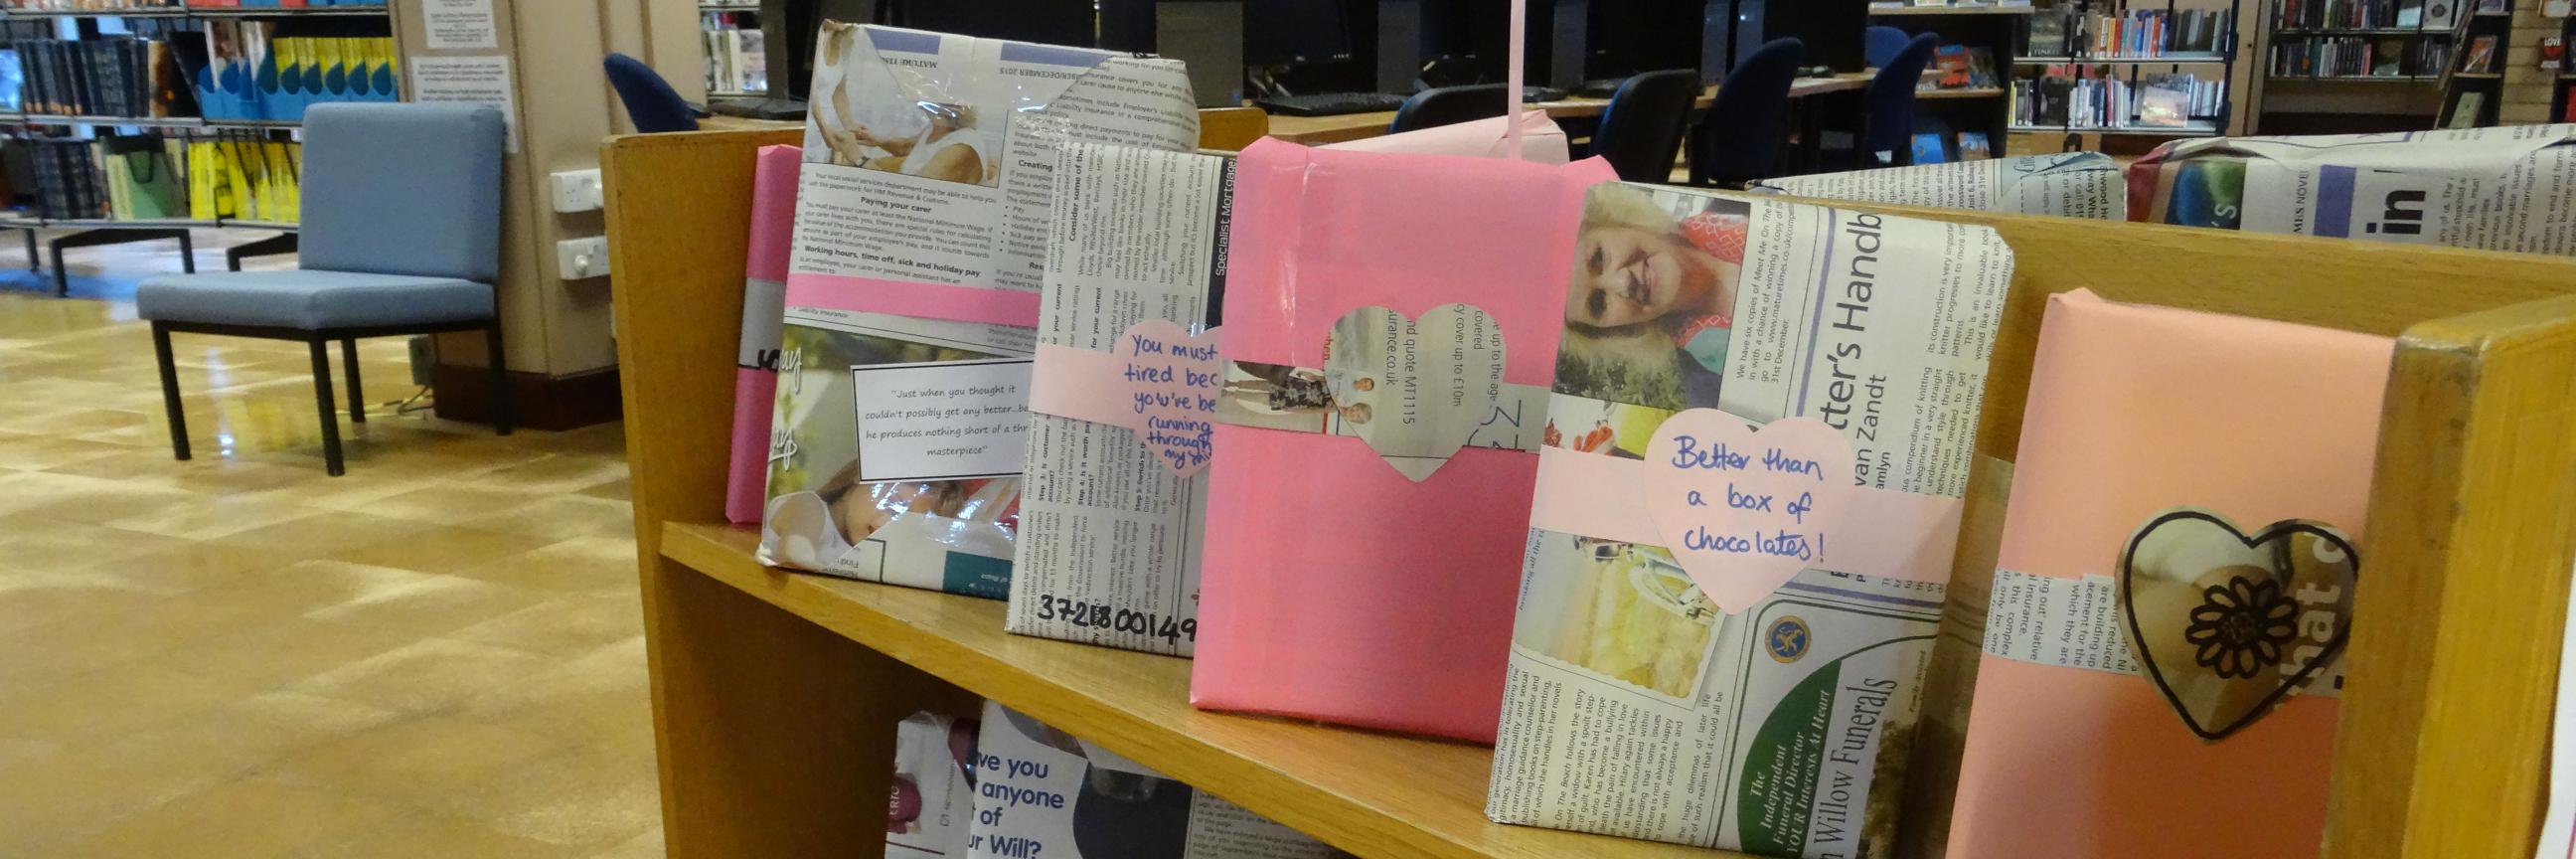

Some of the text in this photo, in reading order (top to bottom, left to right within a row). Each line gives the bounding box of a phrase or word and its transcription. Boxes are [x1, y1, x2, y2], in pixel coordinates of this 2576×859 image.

[1018, 159, 1053, 172] Creating
[861, 196, 932, 214] Paying your carer
[1068, 203, 1080, 242] Consider
[1215, 220, 1230, 276] Specialist
[1760, 241, 1768, 256] Me
[804, 244, 982, 279] Working hours, time off, sick and holiday pay
[1756, 258, 1765, 282] Meet
[1751, 350, 1760, 369] with
[1758, 309, 1768, 337] chance
[1766, 255, 1779, 289] winning
[1775, 221, 1784, 242] copy
[1748, 298, 1757, 325] copies
[1939, 326, 1950, 355] knitter
[1947, 276, 1960, 322] progresses
[1454, 317, 1465, 344] cover
[1473, 310, 1484, 350] covered
[1490, 333, 1502, 347] up
[1775, 318, 1789, 364] December.
[1172, 343, 1219, 361] must
[1402, 338, 1416, 373] quote
[1452, 348, 1464, 361] up
[1491, 350, 1501, 361] to
[1741, 346, 1750, 364] have
[1124, 363, 1175, 383] tired
[1453, 364, 1463, 375] to
[1491, 364, 1502, 380] the
[919, 389, 945, 398] when
[948, 388, 966, 399] you
[968, 385, 1006, 397] thought
[1008, 384, 1017, 394] it
[865, 409, 902, 421] couldn't
[905, 407, 942, 421] possibly
[944, 407, 961, 420] get
[963, 407, 981, 418] any
[1148, 416, 1213, 437] running
[866, 430, 878, 439] he
[880, 429, 922, 441] produces
[924, 426, 962, 438] nothing
[964, 425, 989, 434] short
[991, 423, 1002, 434] of
[1147, 430, 1212, 455] through
[1854, 374, 1887, 487] van Zandt
[1672, 435, 1824, 481] Better than
[1688, 482, 1813, 524] a box of
[2058, 585, 2080, 664] which they are
[2029, 621, 2043, 661] relative
[1575, 688, 1586, 710] story
[1715, 691, 1723, 702] be
[1709, 717, 1719, 741] could
[1829, 677, 1898, 766] Funerals
[1565, 730, 1577, 761] follows
[1007, 758, 1049, 779] you
[1560, 763, 1571, 788] Beach
[1787, 689, 1830, 854] YOUR Interests At Heart
[981, 781, 1065, 809] anyone
[1698, 772, 1709, 800] realism
[1749, 771, 1766, 796] The
[1759, 744, 1788, 830] Independent
[1772, 731, 1805, 846] Funeral Director
[1557, 790, 1567, 805] The
[1813, 770, 1854, 844] Willow
[979, 806, 1003, 827] of
[1694, 803, 1703, 822] such
[989, 833, 1043, 859] Will?
